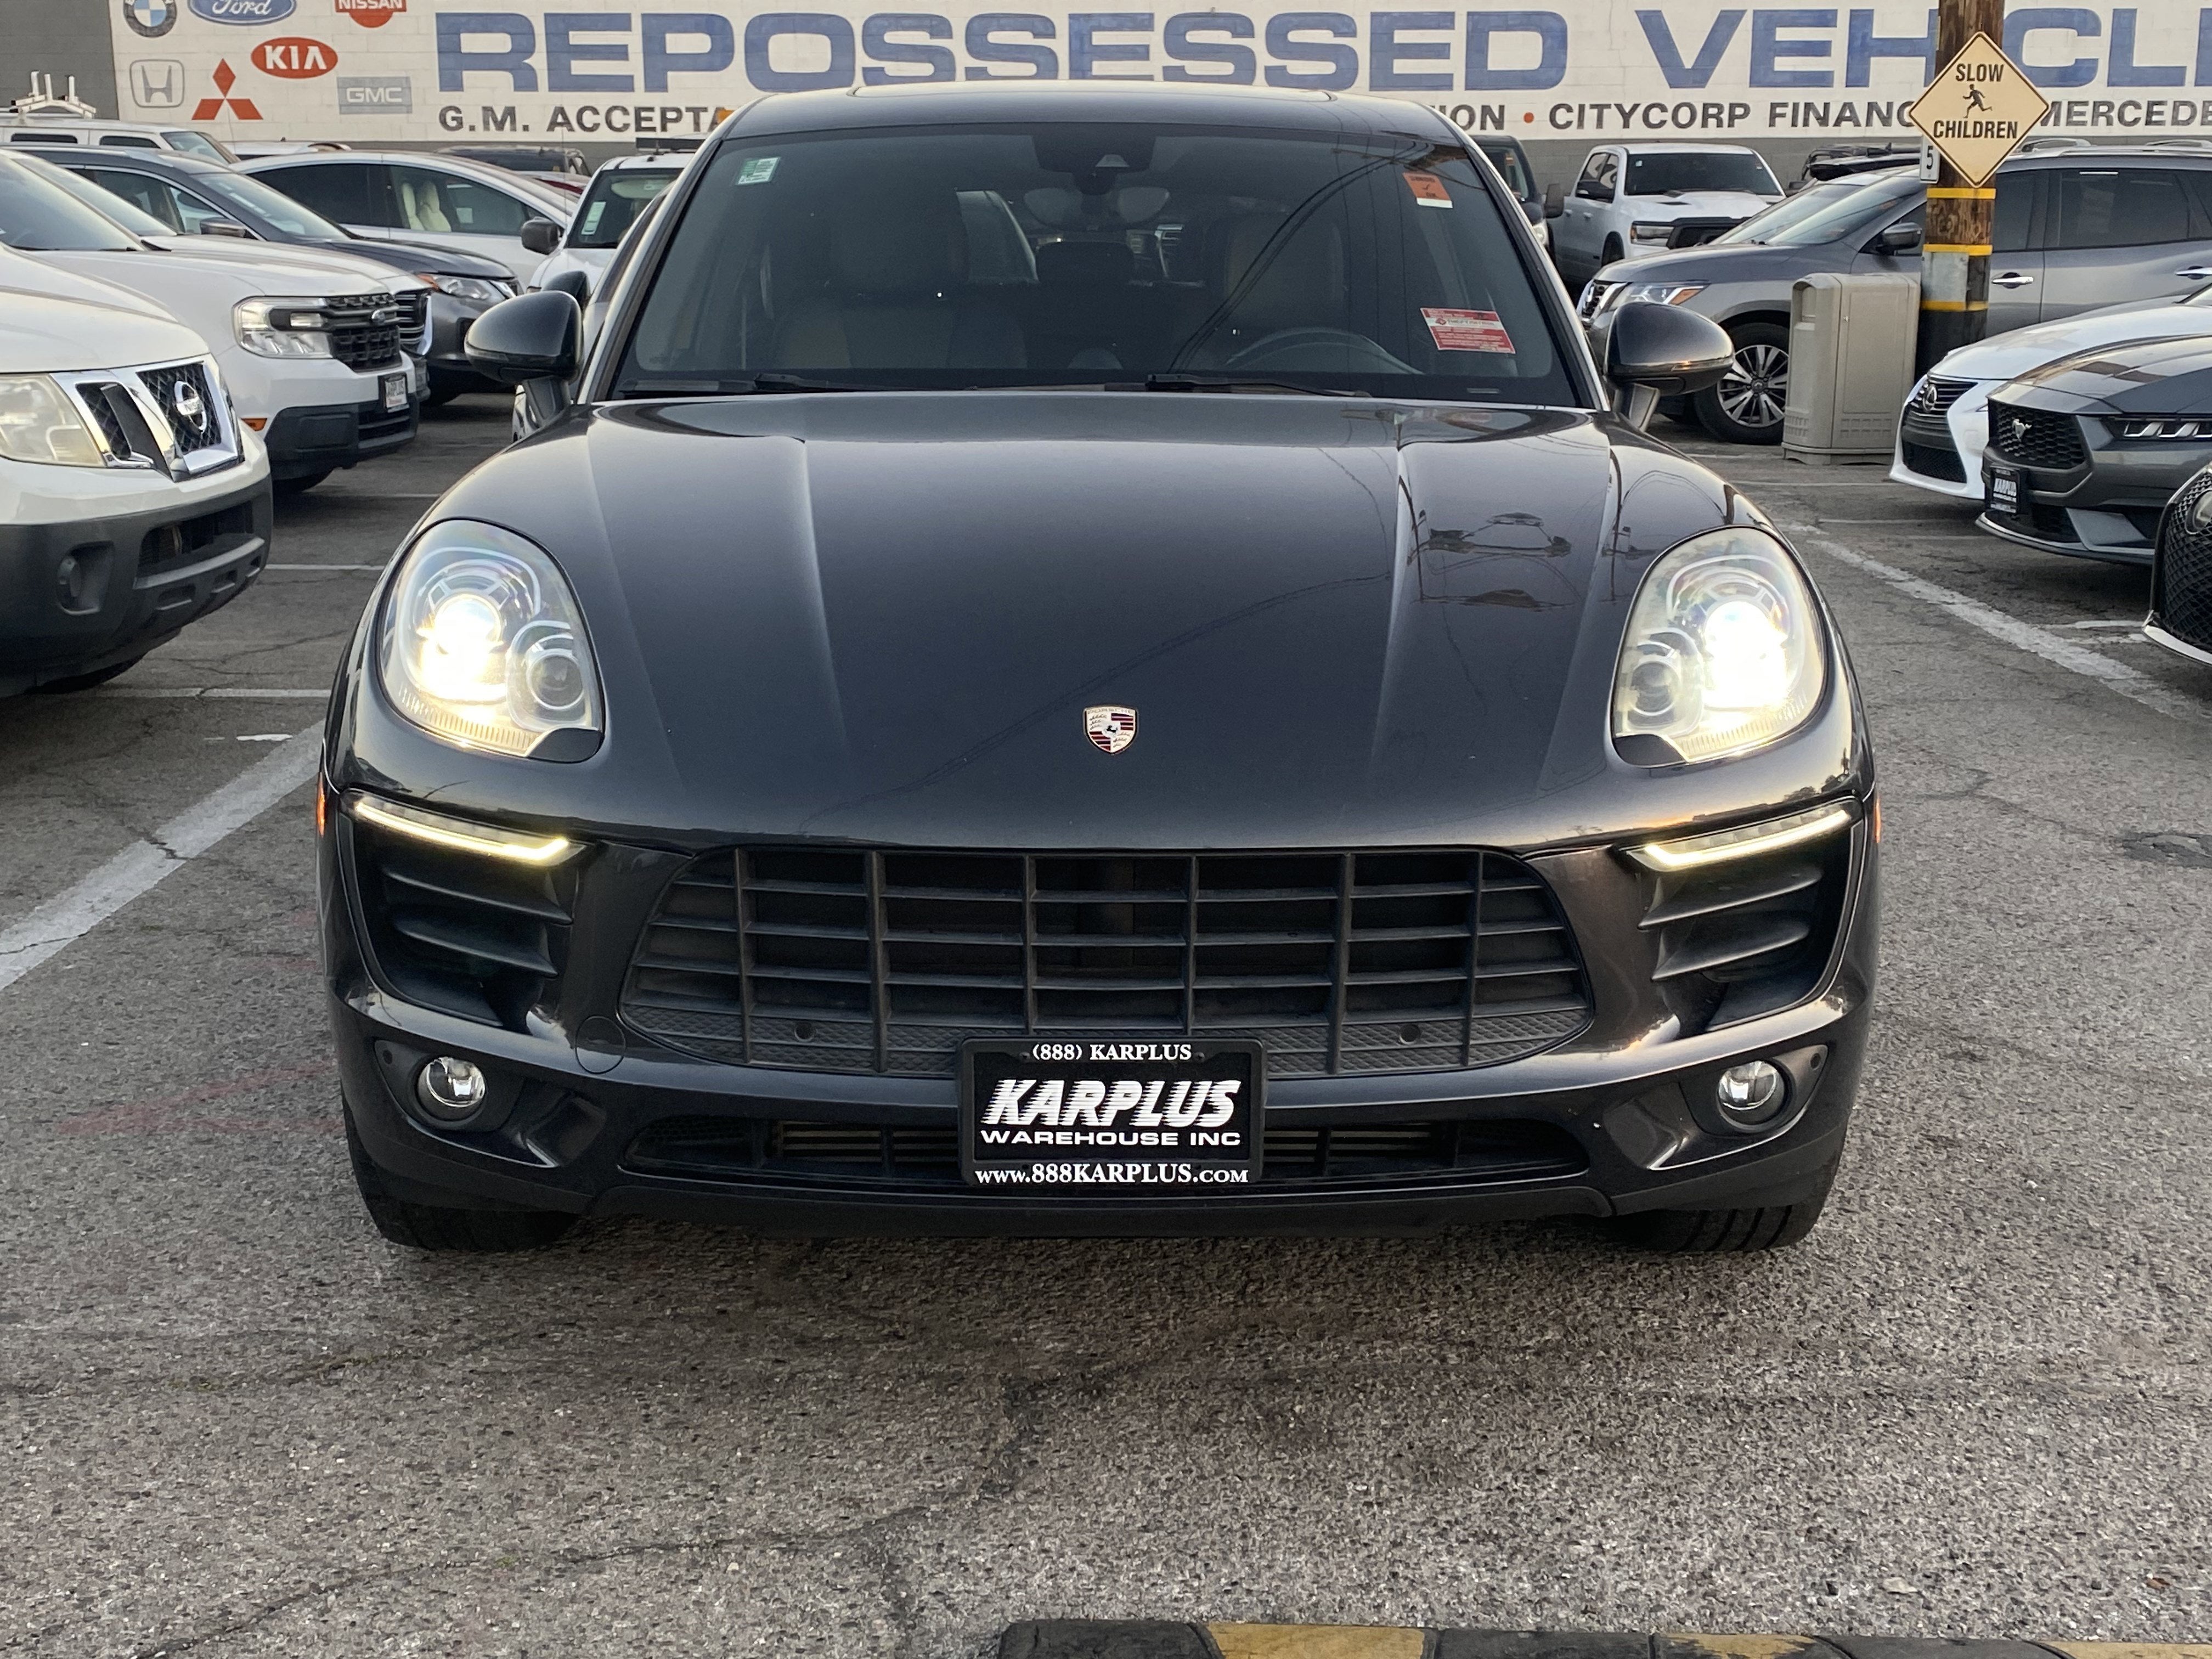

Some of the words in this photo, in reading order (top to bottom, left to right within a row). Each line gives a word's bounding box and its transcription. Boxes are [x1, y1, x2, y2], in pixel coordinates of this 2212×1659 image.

[263, 46, 327, 70] KIA
[435, 10, 1568, 92] REPOSSESSED
[1634, 8, 2212, 88] VEHCL
[1955, 63, 2004, 83] SLOW
[346, 87, 403, 103] GMC
[438, 105, 530, 132] G.M.
[1548, 101, 1751, 130] CITYCORP
[1768, 101, 1915, 127] FINANC
[1933, 120, 2018, 139] CHILDREN
[1032, 1044, 1083, 1061] (888)
[1090, 1044, 1192, 1060] KARPLUS
[980, 1079, 1242, 1128] KARPLUS
[980, 1130, 1178, 1146] WAREHOUSE
[1190, 1132, 1241, 1146] INC
